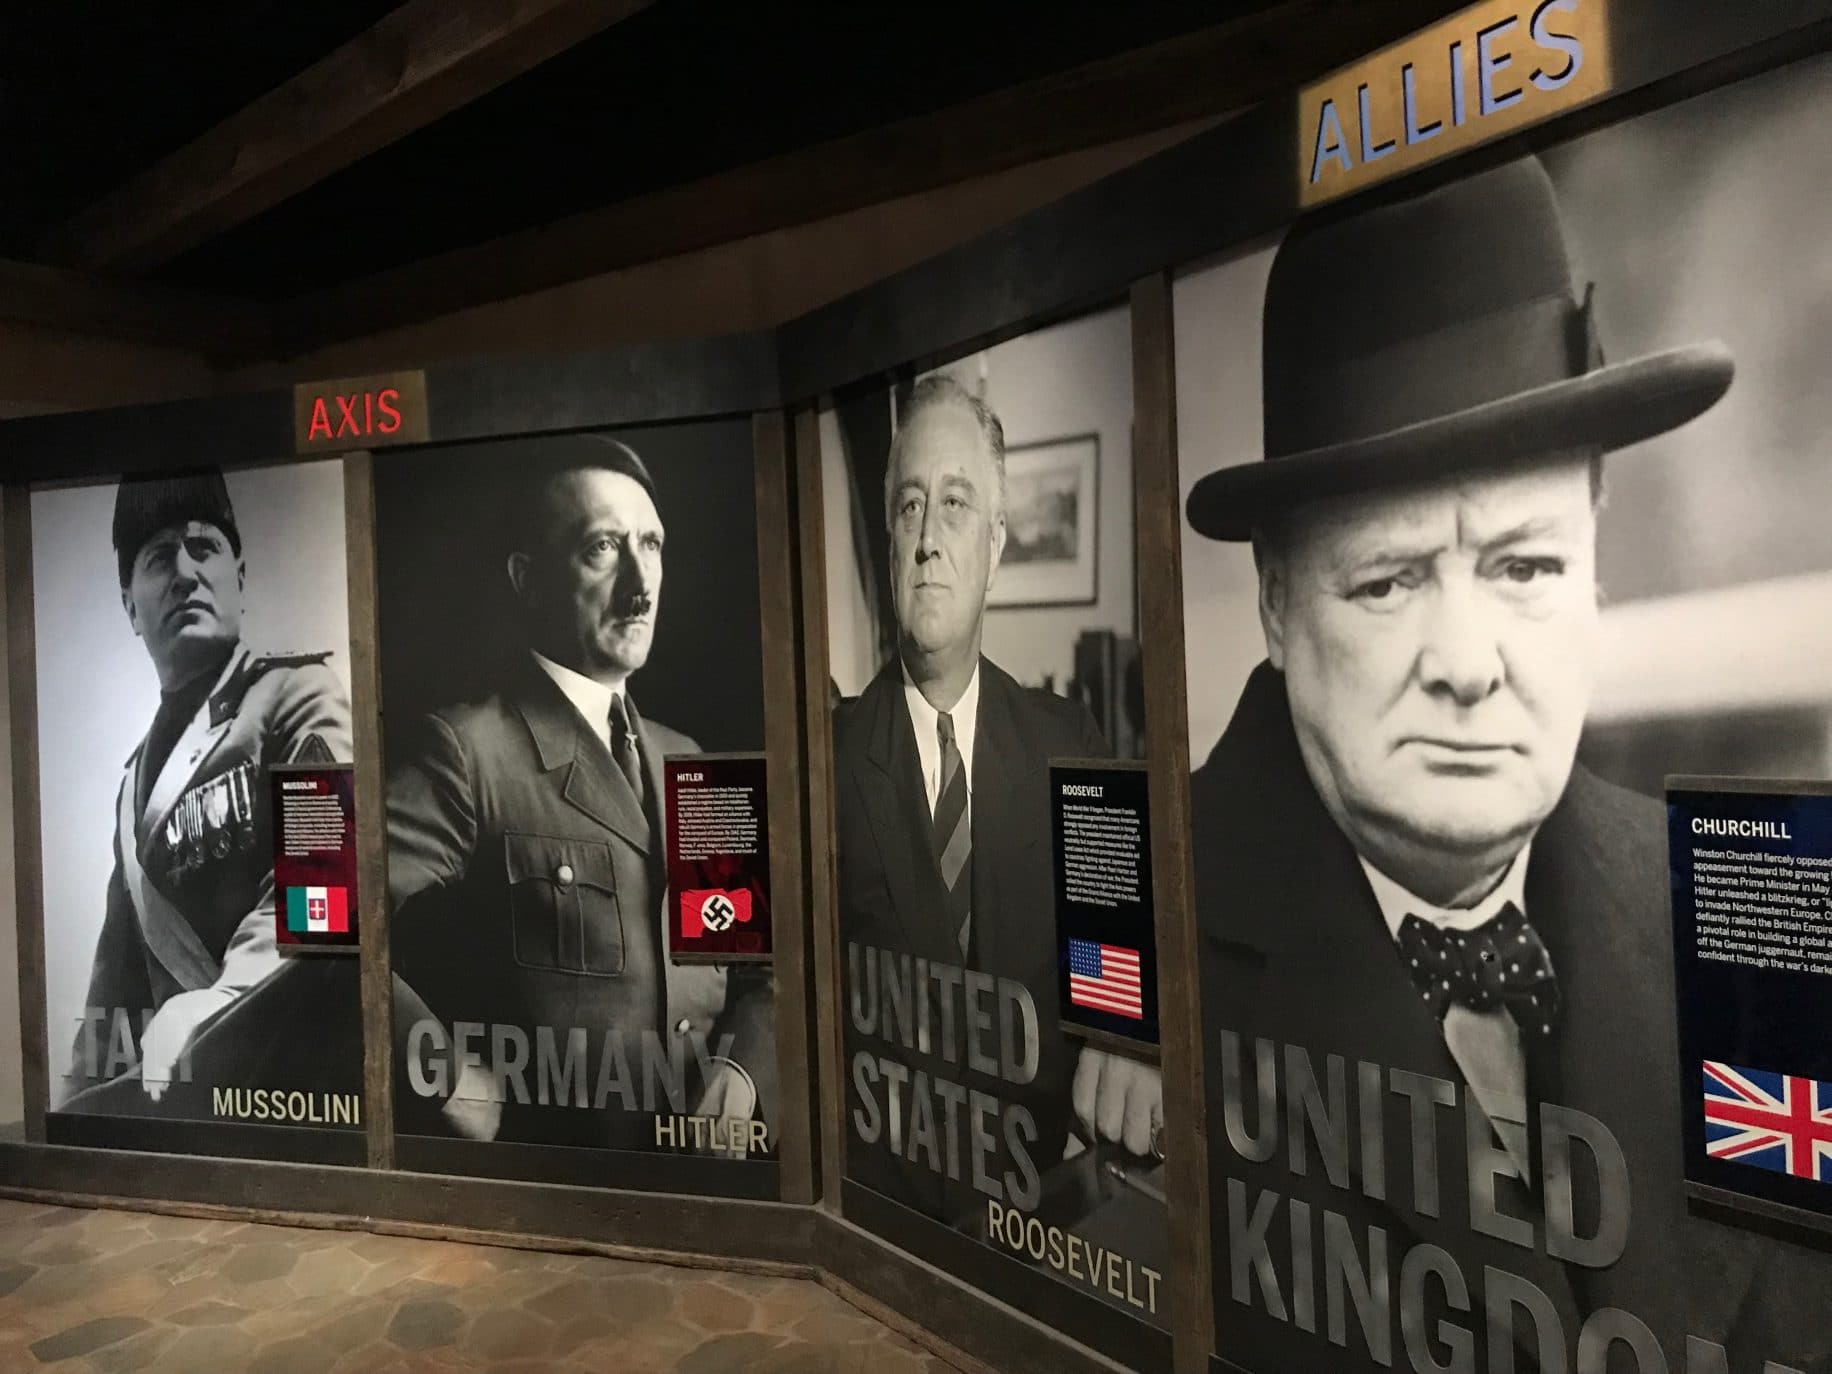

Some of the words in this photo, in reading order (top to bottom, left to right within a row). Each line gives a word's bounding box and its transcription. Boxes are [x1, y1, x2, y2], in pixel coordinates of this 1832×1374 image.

[1310, 0, 1584, 184] ALLIES
[308, 388, 402, 441] AXIS
[677, 772, 704, 781] HITLER
[1062, 784, 1104, 797] ROOSEVELT
[1691, 817, 1792, 839] CHURCHILL
[1692, 848, 1725, 859] Winston
[1726, 850, 1763, 861] Churchill
[1764, 852, 1795, 866] fiercely
[1693, 862, 1748, 873] appeasement
[1749, 865, 1778, 876] toward
[1779, 867, 1793, 877] the
[1794, 870, 1830, 882] growing
[1694, 873, 1706, 883] He
[1706, 874, 1739, 886] became
[1740, 876, 1765, 888] Prime
[1766, 879, 1800, 891] Minister
[1802, 881, 1810, 892] in
[1811, 883, 1831, 896] May
[1694, 886, 1716, 896] Hitler
[1718, 889, 1760, 901] unleashed
[1761, 894, 1767, 902] a
[1811, 898, 1821, 906] or
[1695, 899, 1704, 908] to
[1705, 900, 1731, 911] invade
[1732, 902, 1789, 916] Northwestern
[1790, 908, 1823, 921] Europe.
[1696, 912, 1730, 925] defiantly
[1731, 915, 1757, 926] rallied
[1758, 917, 1773, 928] the
[1773, 919, 1802, 931] British
[1697, 937, 1709, 946] off
[1709, 938, 1723, 948] the
[1724, 940, 1757, 952] German
[1703, 926, 1730, 936] pivotal
[1731, 928, 1747, 938] role
[1748, 929, 1757, 939] in
[1757, 930, 1791, 945] building
[1792, 936, 1798, 944] a
[1799, 935, 1826, 947] global
[1697, 951, 1736, 962] confident
[1736, 953, 1770, 968] through
[1770, 957, 1785, 969] the
[849, 941, 1039, 1085] UNITED
[406, 1018, 736, 1116] GERMANY
[212, 1087, 361, 1125] MUSSOLINI
[654, 1114, 769, 1153] HITLER
[852, 1050, 1042, 1213] STATES
[1220, 1029, 1631, 1269] UNITED
[988, 1199, 1163, 1315] ROOSEVELT
[1227, 1177, 1806, 1374] KINGD
